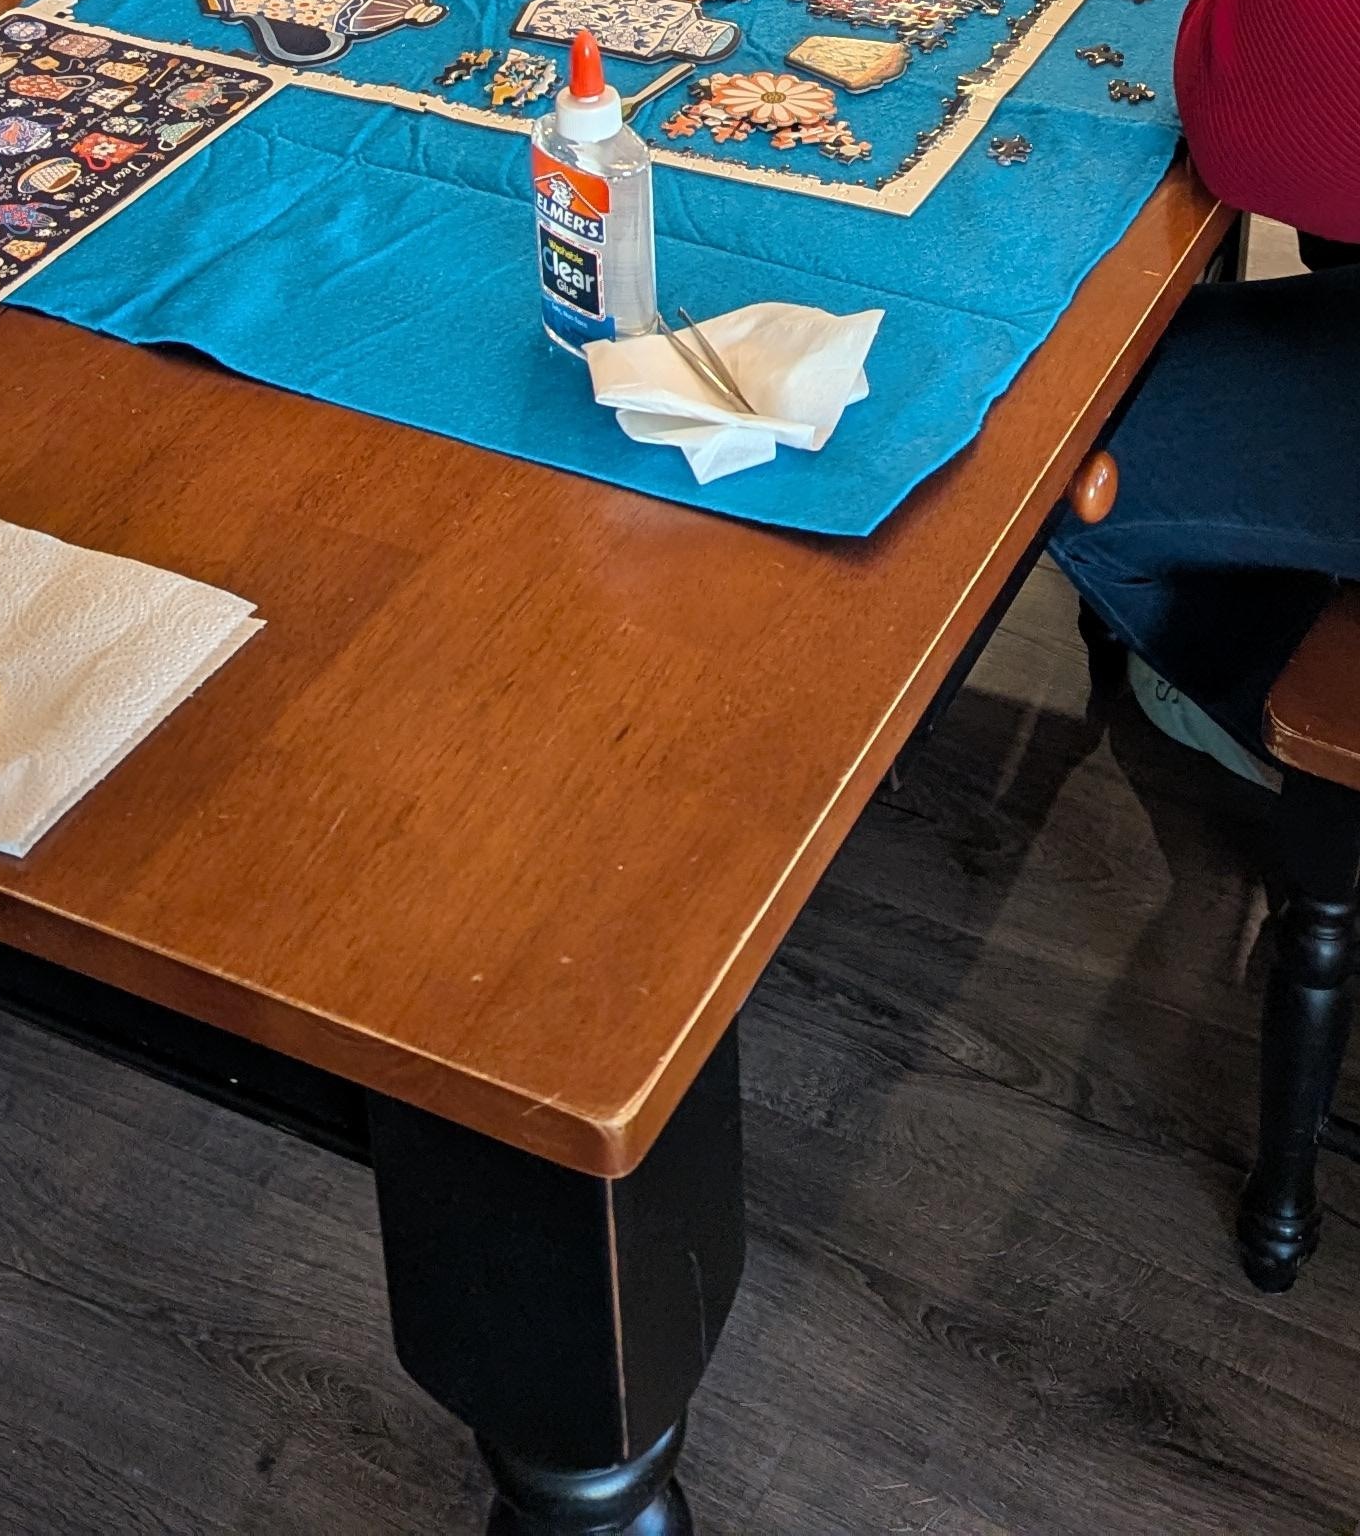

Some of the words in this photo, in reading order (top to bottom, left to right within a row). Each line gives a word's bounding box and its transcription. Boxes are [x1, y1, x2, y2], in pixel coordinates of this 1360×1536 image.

[79, 180, 124, 204] Time
[537, 193, 599, 238] ELMER'S
[549, 239, 584, 265] Washable
[543, 247, 595, 293] Clear
[557, 281, 578, 298] Glue
